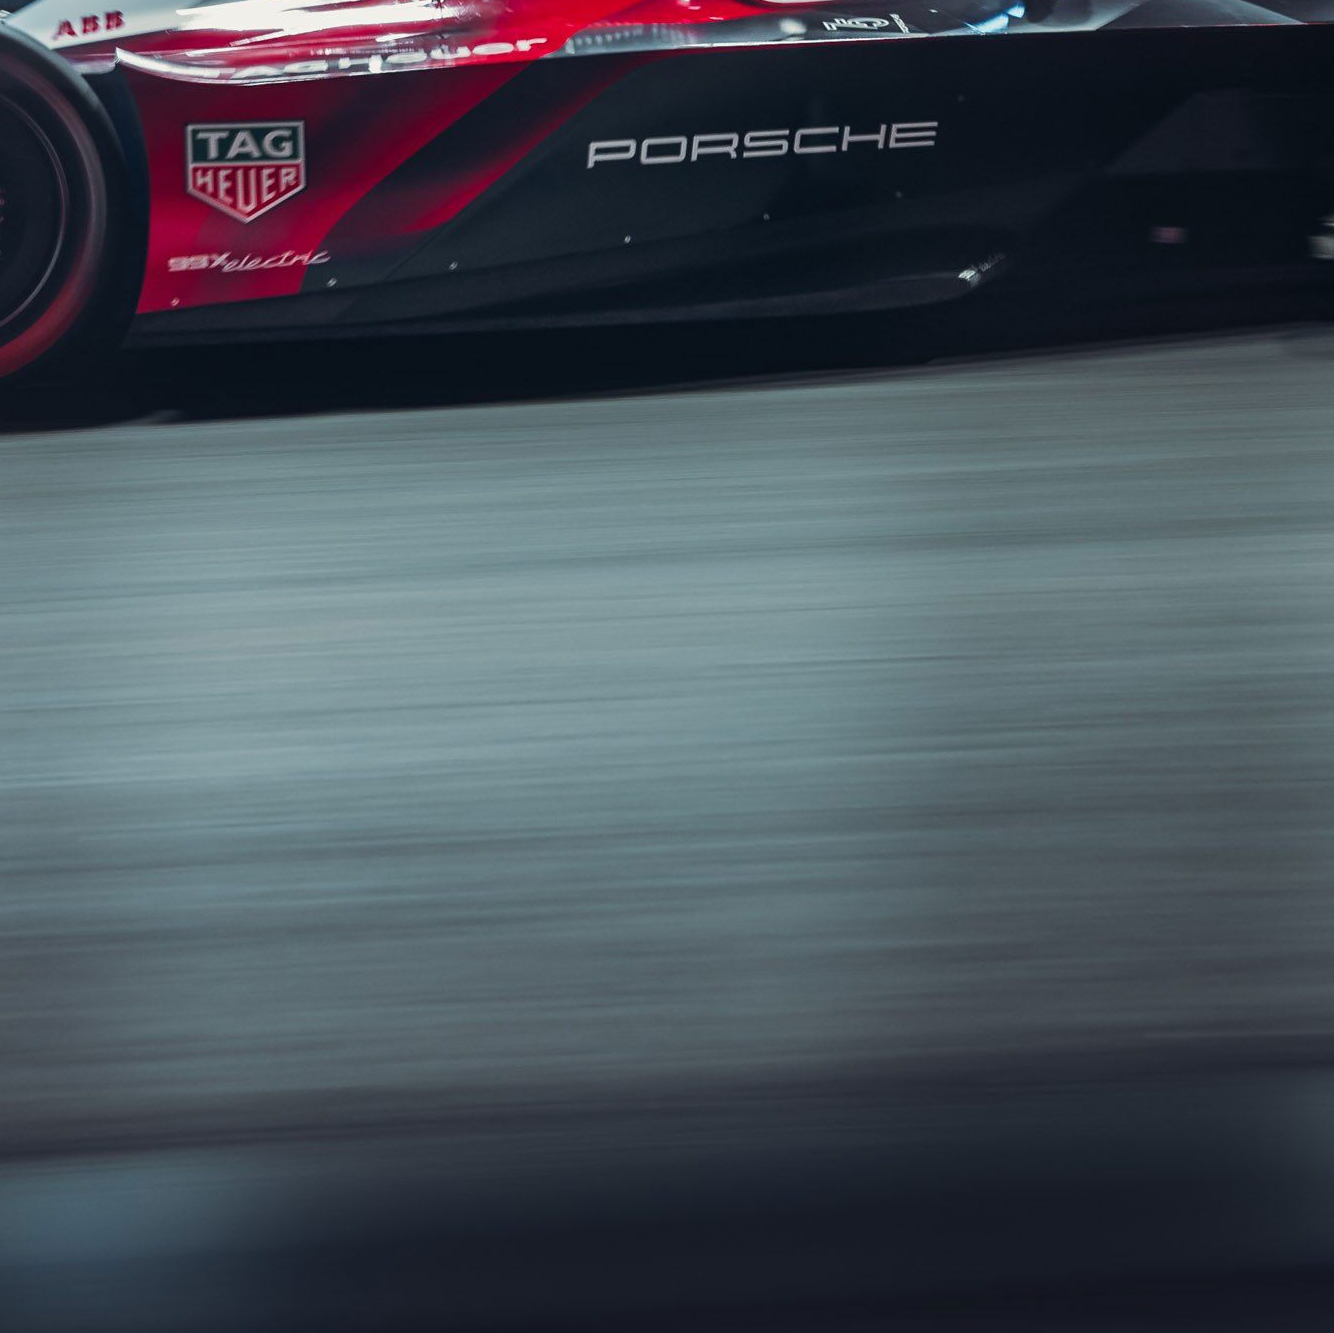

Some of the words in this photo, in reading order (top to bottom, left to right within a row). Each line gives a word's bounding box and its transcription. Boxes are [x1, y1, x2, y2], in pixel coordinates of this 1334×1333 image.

[54, 10, 125, 40] ABB
[196, 129, 294, 160] TAG
[586, 121, 938, 169] PORSCHE
[195, 167, 297, 213] HEUER
